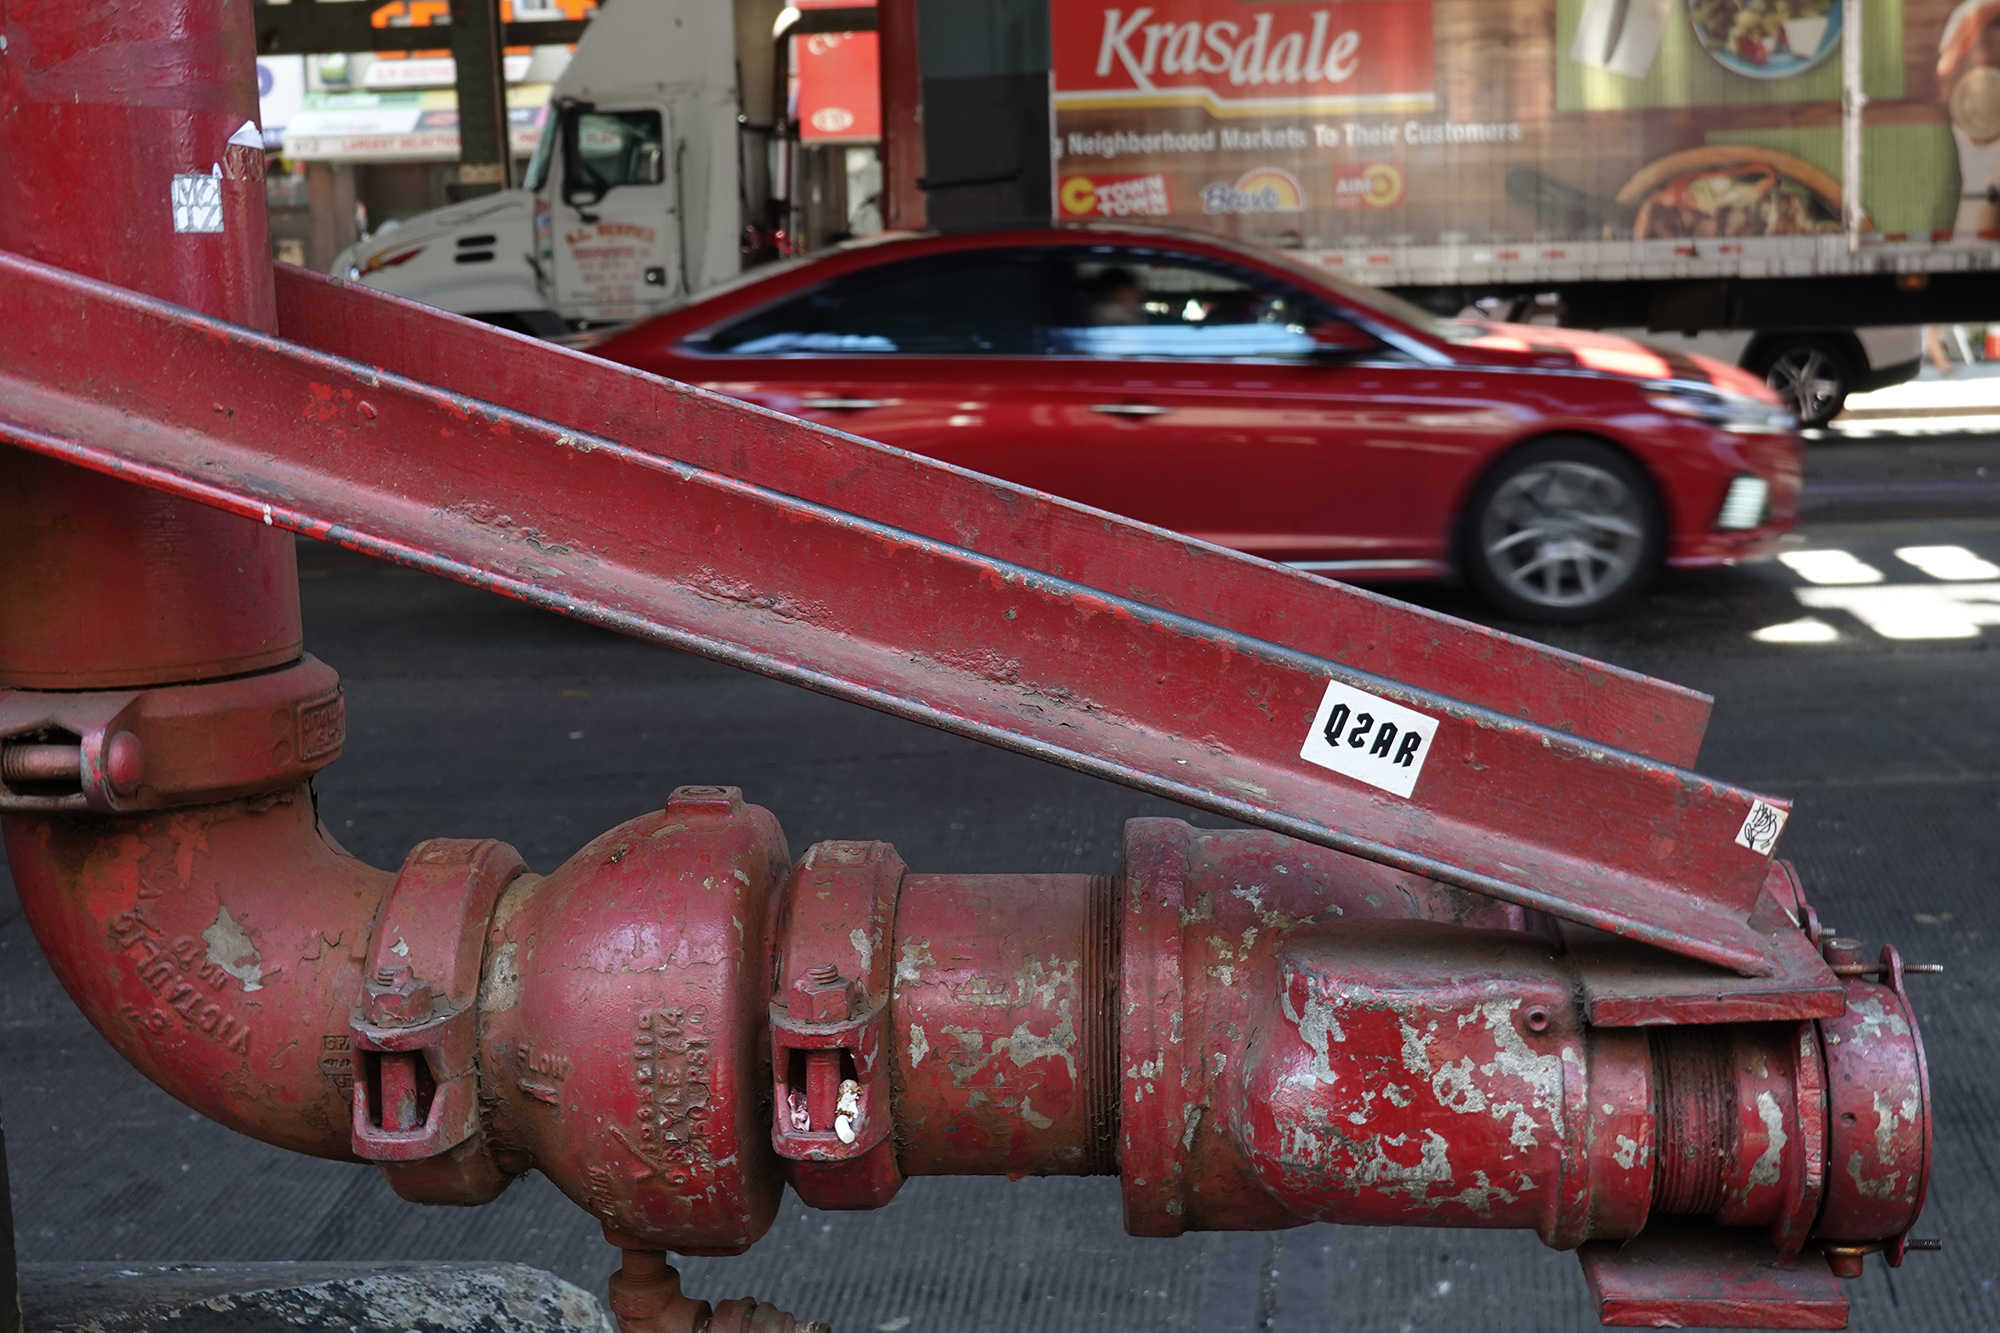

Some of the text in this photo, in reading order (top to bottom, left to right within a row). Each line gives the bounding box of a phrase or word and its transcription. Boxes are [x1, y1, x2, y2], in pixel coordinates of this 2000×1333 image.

[1096, 8, 1361, 93] Krasdale
[1069, 130, 1216, 158] Neighborhood
[1221, 127, 1307, 149] Markets
[1313, 123, 1339, 148] To
[1343, 120, 1399, 147] Their
[1404, 120, 1522, 145] Customers
[1202, 182, 1279, 214] Bravo
[516, 1043, 569, 1082] FLOW
